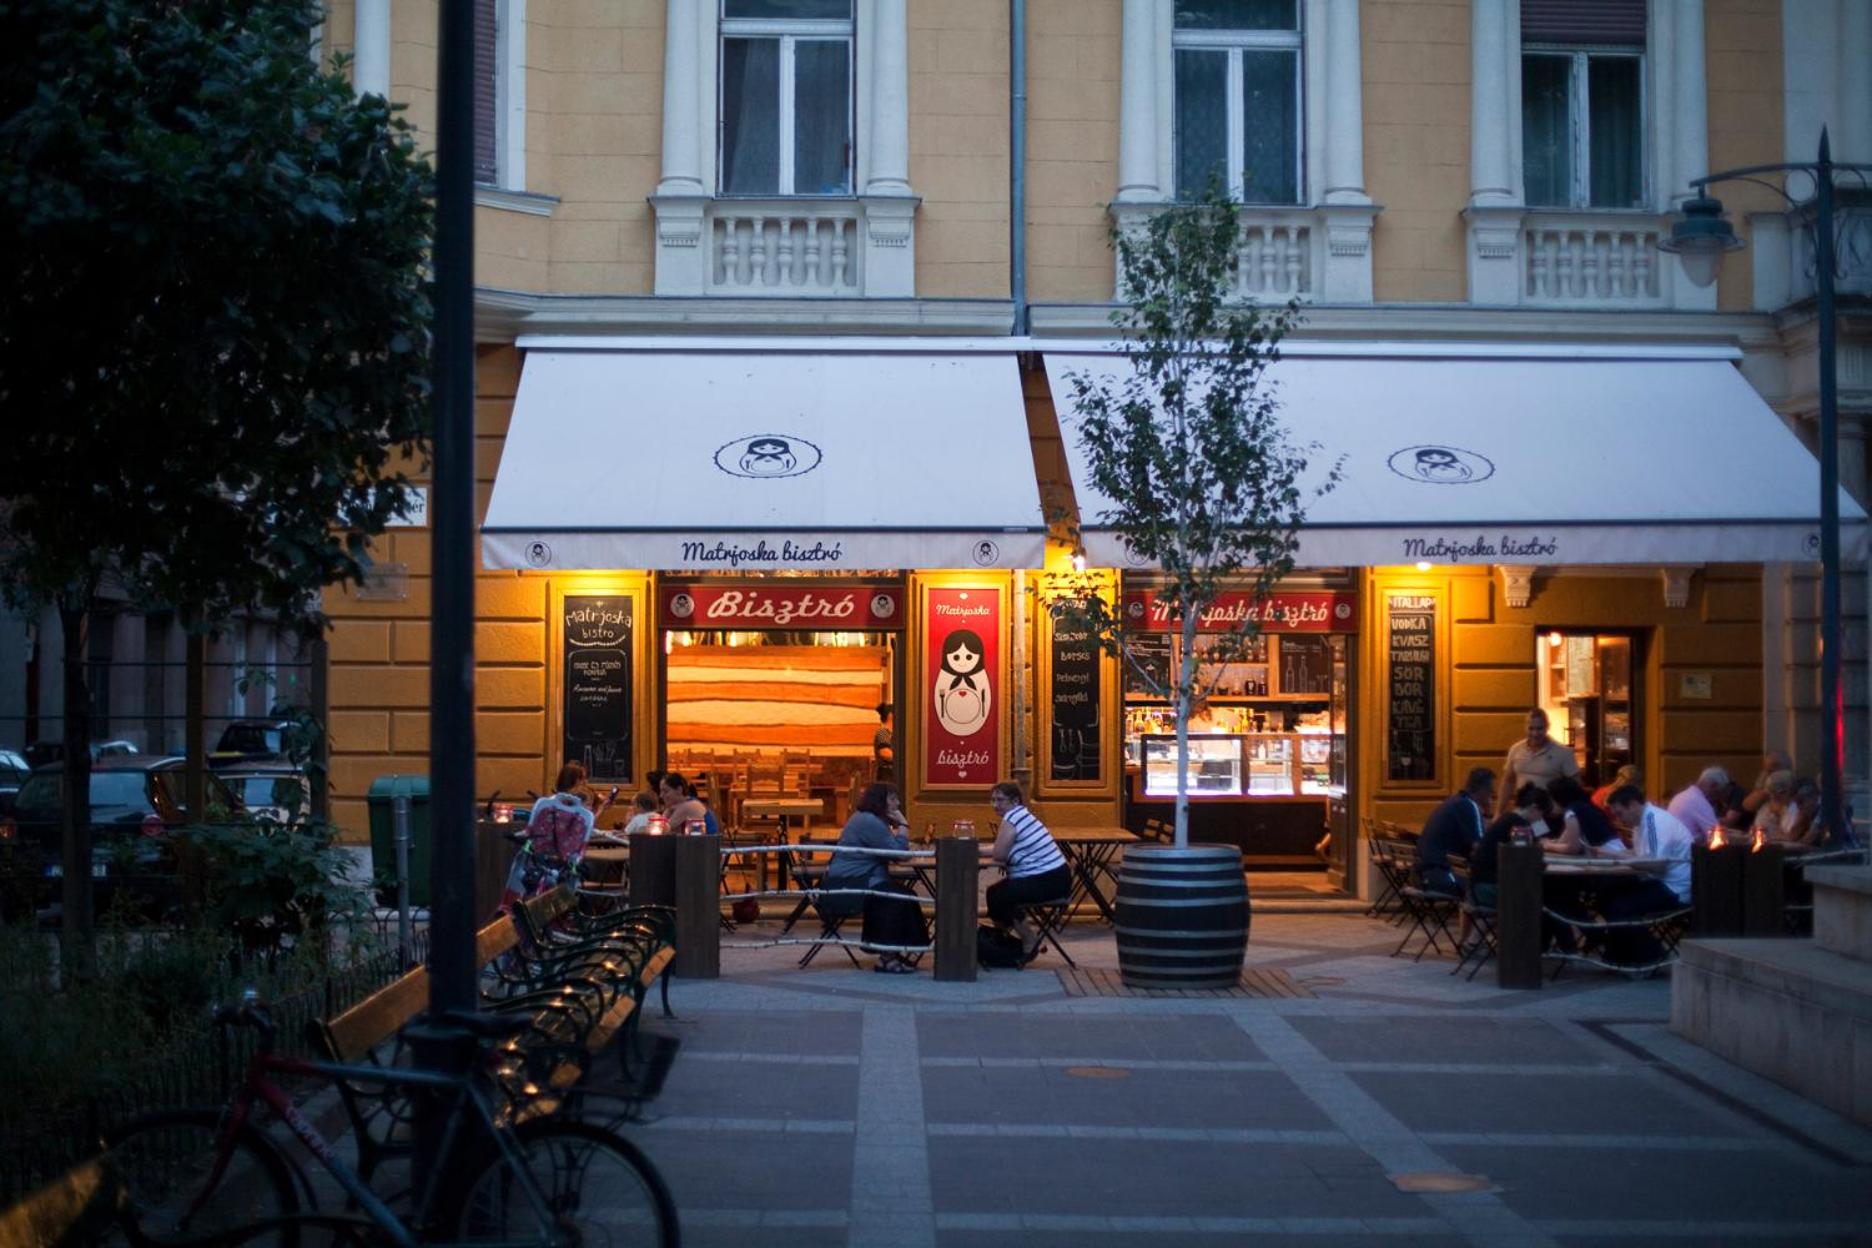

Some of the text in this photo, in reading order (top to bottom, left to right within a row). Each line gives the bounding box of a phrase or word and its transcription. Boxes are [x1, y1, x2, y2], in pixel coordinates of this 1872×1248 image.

[682, 540, 842, 567] Matrjoska bisztró
[1403, 535, 1558, 561] Matrjoska bisztró
[707, 590, 854, 625] Bisztró
[936, 604, 990, 616] Matrjoska
[1392, 597, 1432, 609] ITALLAP
[566, 608, 632, 628] Matrjoska
[1391, 618, 1426, 630] VODKA
[582, 627, 614, 639] bistro
[1394, 682, 1424, 697] BOR
[937, 749, 990, 768] bisztró
